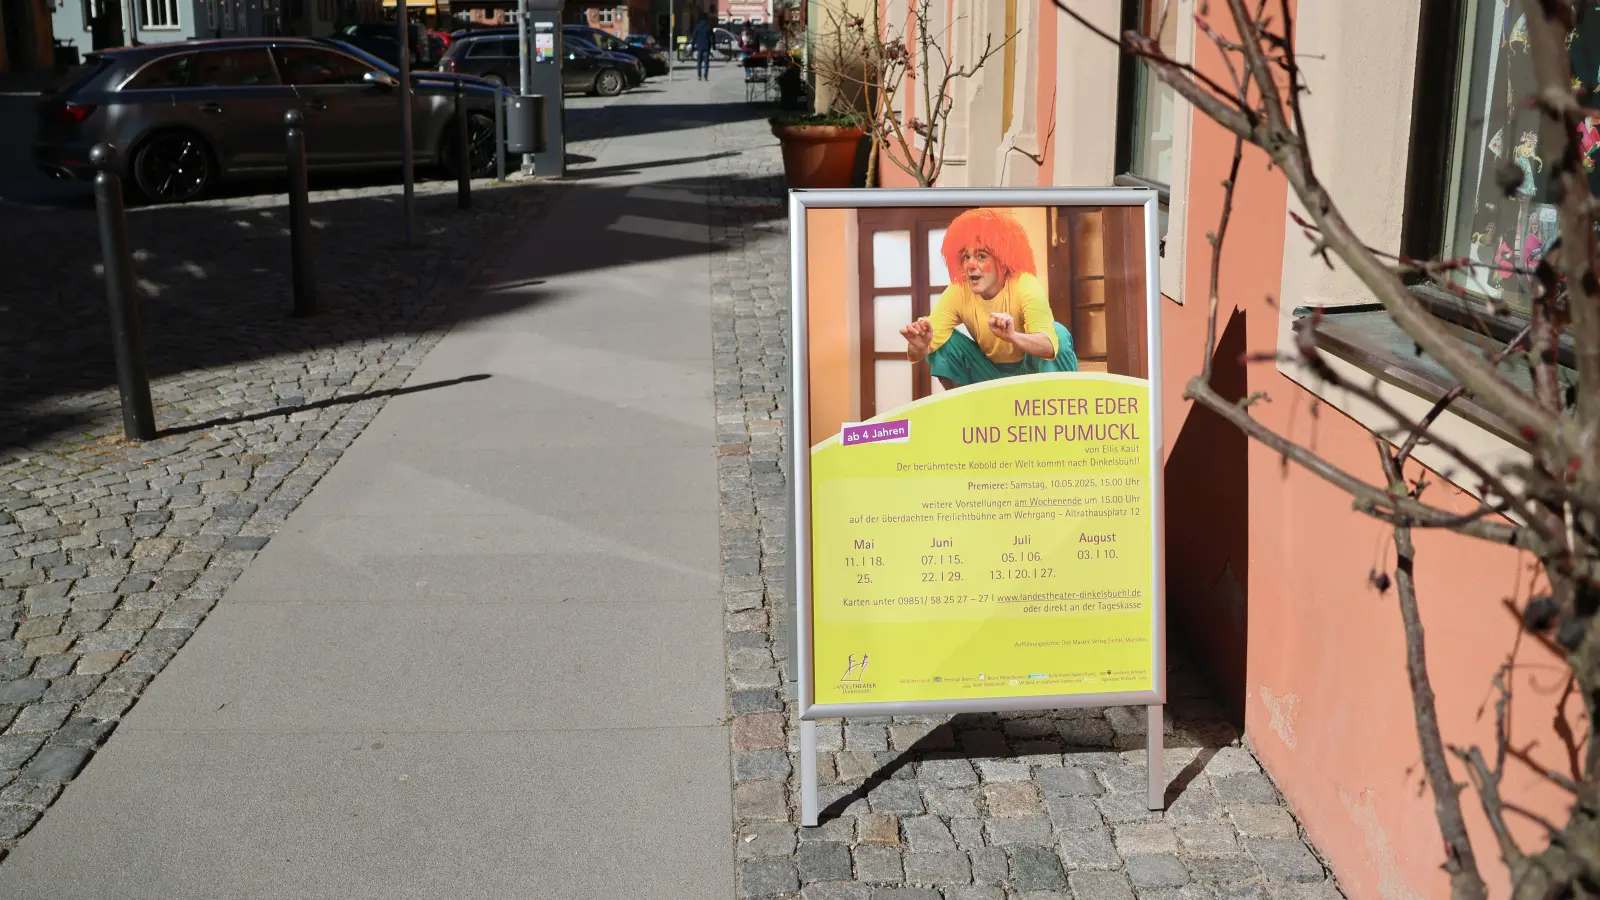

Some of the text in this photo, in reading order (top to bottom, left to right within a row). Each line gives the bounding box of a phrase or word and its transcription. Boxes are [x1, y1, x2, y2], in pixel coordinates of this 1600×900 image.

[1015, 398, 1138, 416] MEISTER EDER
[848, 432, 859, 441] ab
[872, 428, 904, 437] Jahren
[963, 423, 1140, 444] UND SEIN PUMUCKL
[1103, 445, 1118, 454] Ellis
[897, 463, 911, 471] Der
[914, 462, 966, 470] berühmteste
[969, 461, 996, 469] Kobold
[1015, 460, 1034, 468] Welt
[1090, 457, 1139, 466] Dinkelsbühl!
[968, 478, 1140, 490] Premiere: Samstag, 10.05.2025, 15.00 Uhr
[955, 499, 1011, 509] Vorstellungen
[1030, 497, 1082, 506] Wochenende
[1126, 495, 1140, 503] Uhr
[850, 515, 863, 523] auf
[866, 515, 879, 523] der
[882, 514, 934, 522] überdachten
[937, 512, 996, 521] Freilichtbühne
[1014, 511, 1055, 520] Wehrgang
[1065, 508, 1127, 518] Altrathausplatz
[854, 539, 874, 549] Mai
[930, 537, 952, 548] Juni
[1013, 535, 1030, 545] Juli
[1079, 532, 1116, 545] August
[921, 556, 936, 565] 07.
[948, 555, 964, 564] 15.
[1002, 553, 1017, 562] 05.
[1028, 552, 1042, 561] 06.
[1078, 550, 1092, 560] 03.
[1104, 549, 1118, 558] 10.
[845, 558, 858, 566] 11.
[870, 556, 884, 566] 18.
[857, 574, 872, 584] 25.
[922, 572, 937, 582] 22.
[948, 572, 963, 581] 29.
[990, 570, 1004, 580] 13.
[1015, 569, 1030, 579] 20.
[1041, 568, 1056, 578] 27.
[843, 598, 870, 606] Karten
[898, 596, 927, 605] 09851/
[931, 596, 941, 604] 58
[957, 595, 968, 603] 27
[979, 594, 988, 602] 27
[997, 589, 1141, 604] www.landestheater-dinkelsbuehl.de
[1024, 605, 1041, 613] oder
[1044, 604, 1067, 612] direkt
[1098, 601, 1141, 612] Tageskasse
